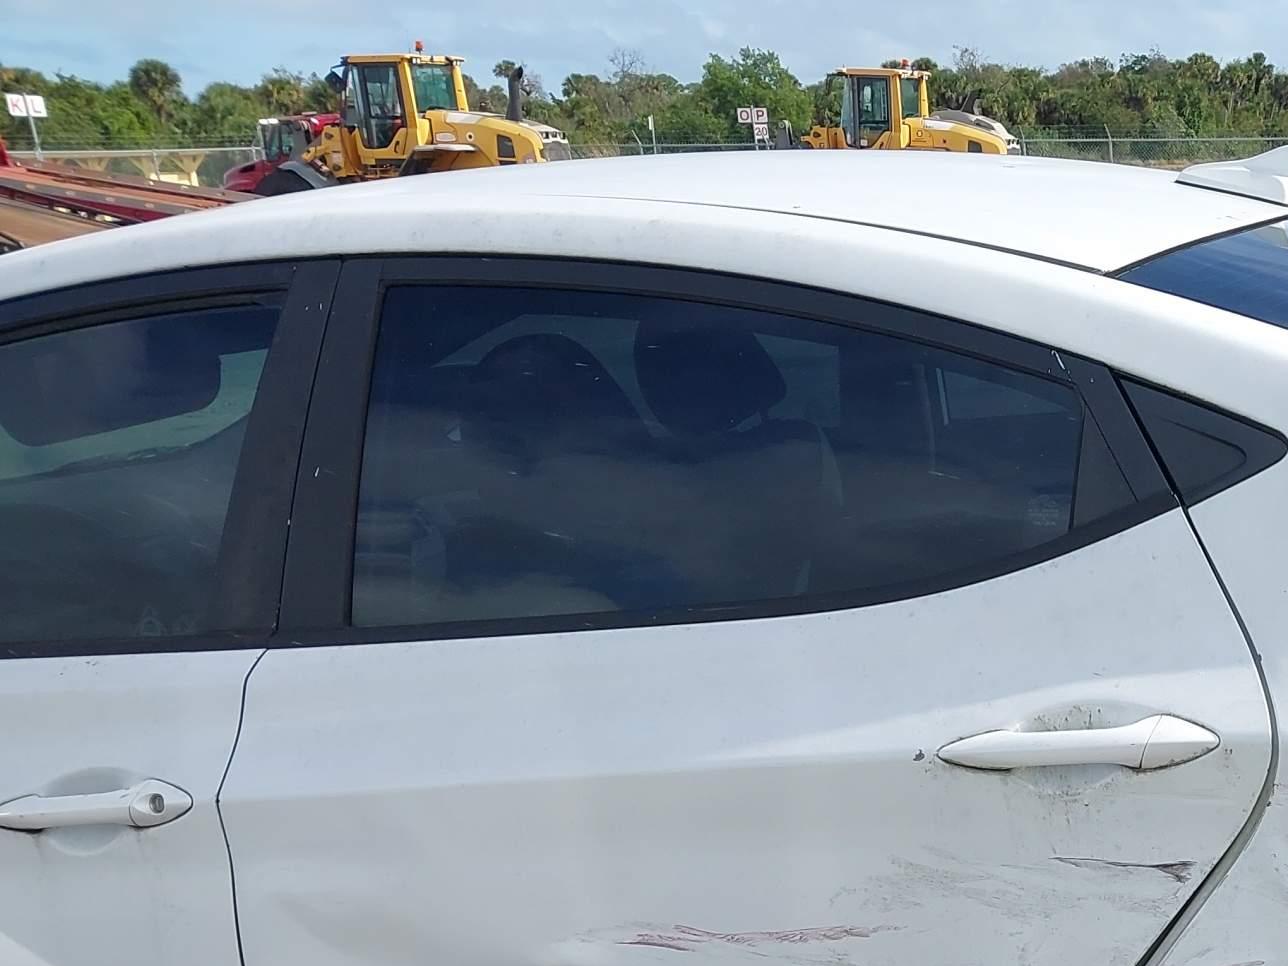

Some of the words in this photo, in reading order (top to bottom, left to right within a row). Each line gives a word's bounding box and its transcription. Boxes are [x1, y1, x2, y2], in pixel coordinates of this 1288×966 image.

[10, 97, 23, 113] K
[30, 98, 42, 114] L
[756, 110, 765, 121] P
[755, 127, 768, 137] 20
